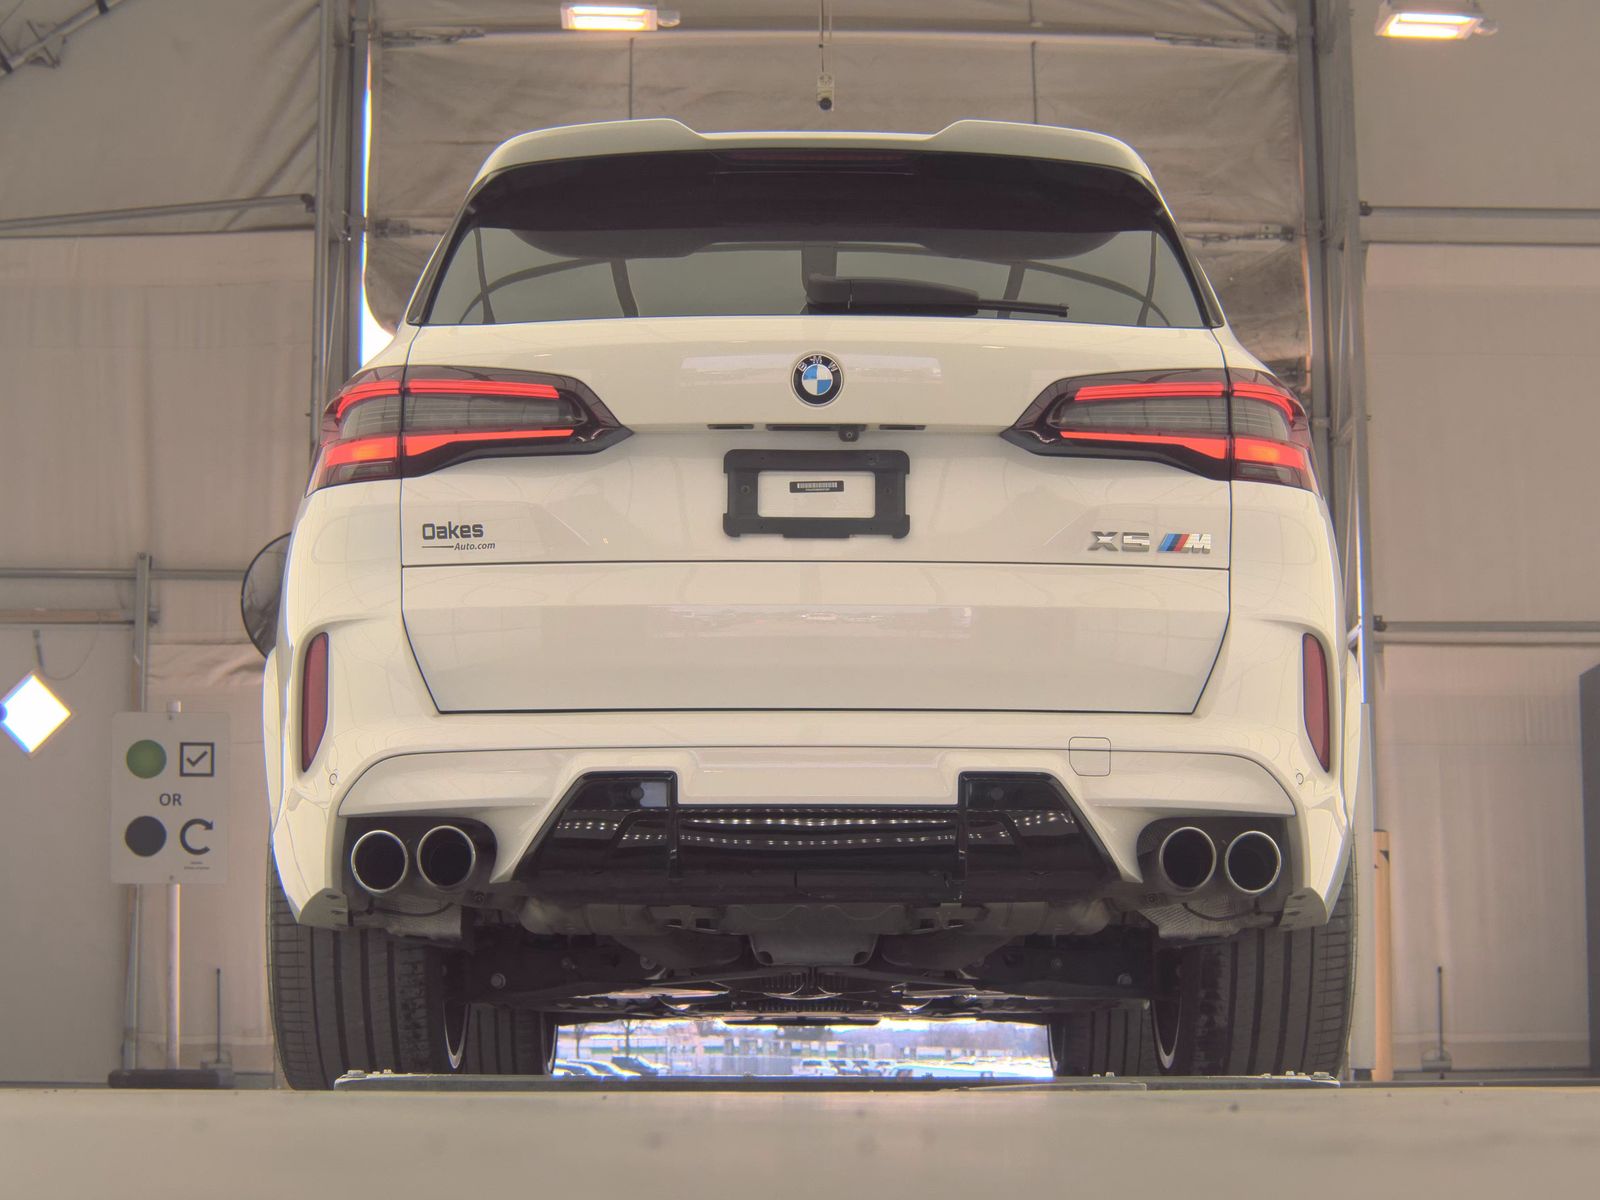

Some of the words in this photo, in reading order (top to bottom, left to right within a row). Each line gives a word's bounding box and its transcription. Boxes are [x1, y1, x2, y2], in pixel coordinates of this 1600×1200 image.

[797, 355, 839, 372] BMW
[422, 521, 484, 540] Oakes
[454, 542, 496, 551] Auto.com
[1087, 531, 1151, 553] X5
[1179, 533, 1212, 554] M
[159, 793, 182, 807] OR
